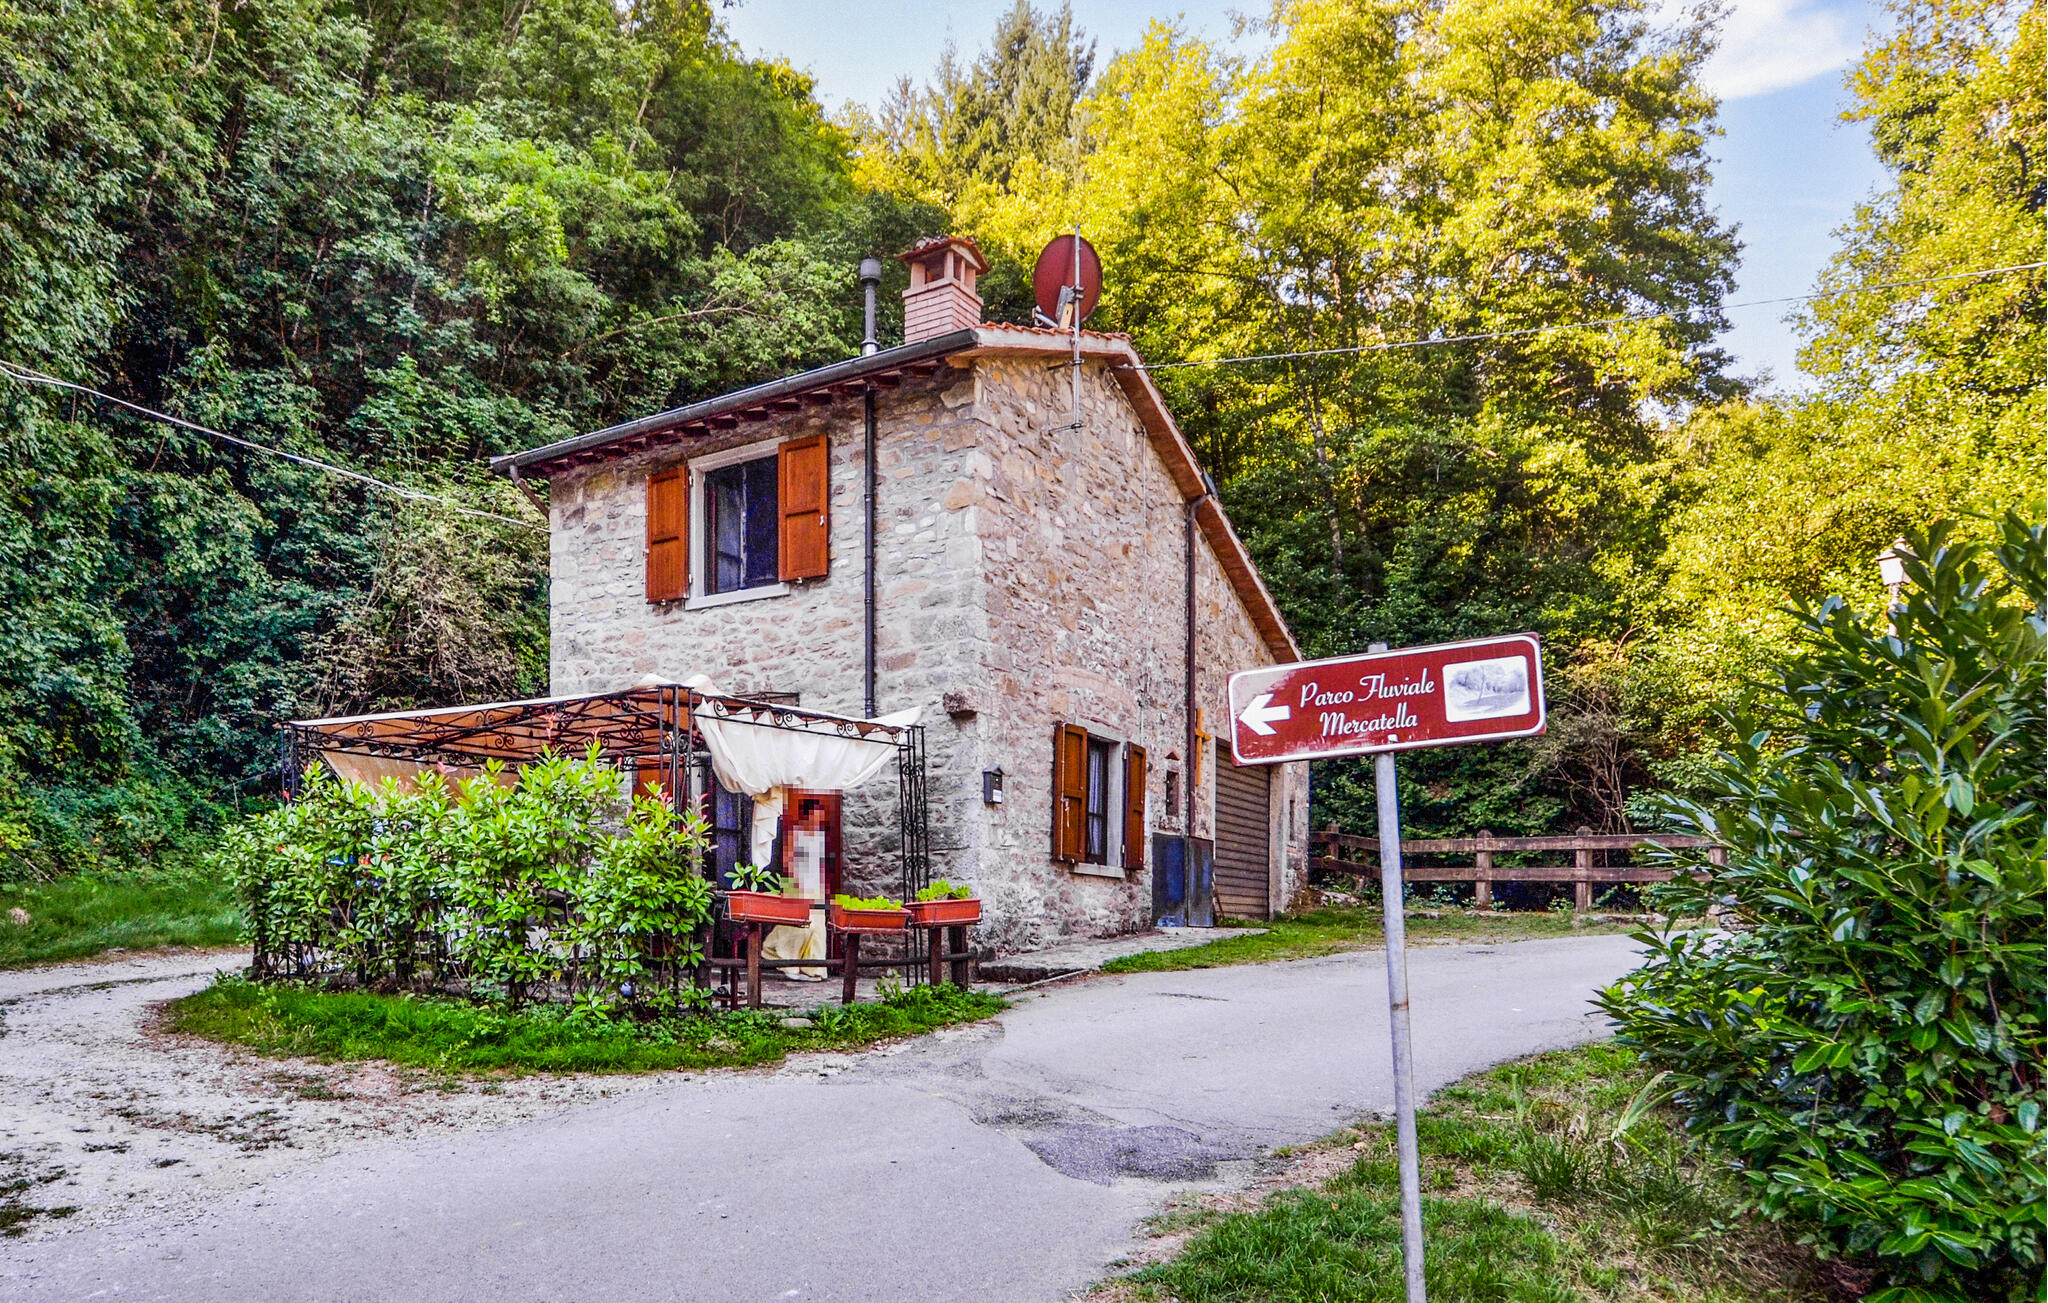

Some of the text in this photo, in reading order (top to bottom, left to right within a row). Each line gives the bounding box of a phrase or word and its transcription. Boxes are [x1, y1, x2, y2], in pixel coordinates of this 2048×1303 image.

[1300, 667, 1435, 708] Parco Fluviale
[1320, 702, 1418, 737] Mercatella
